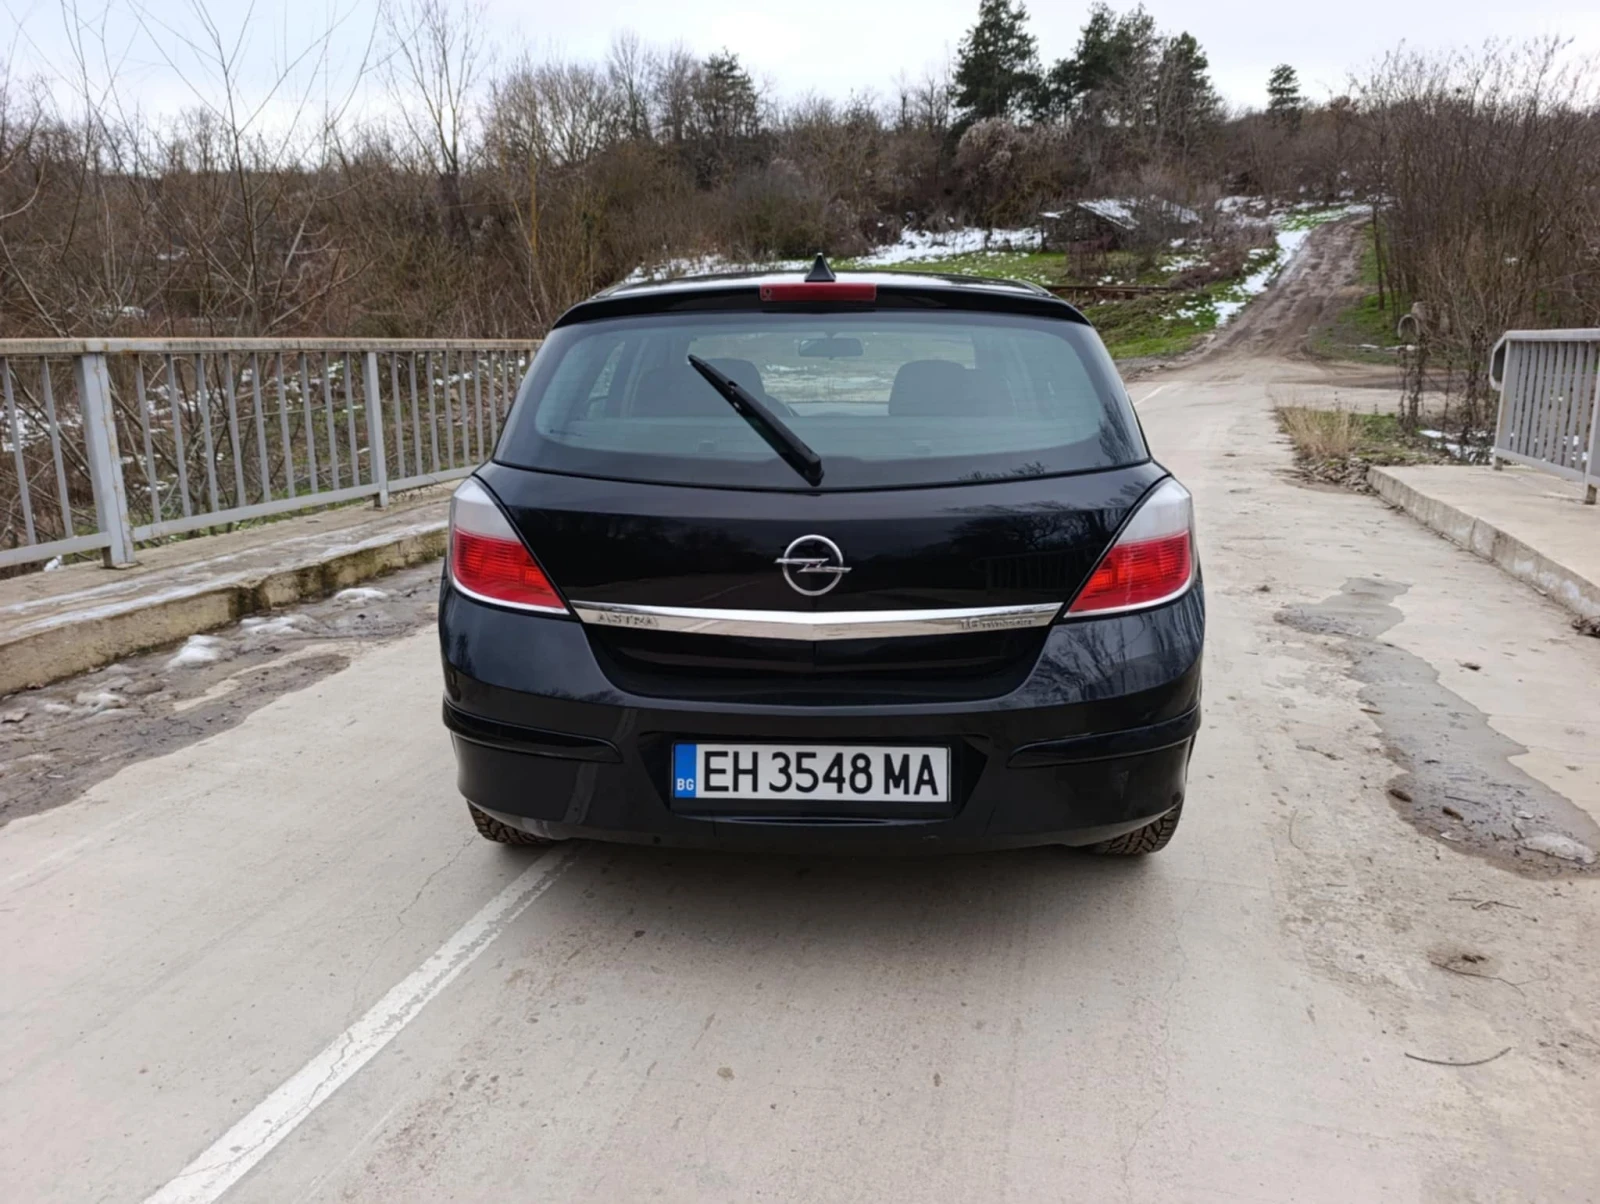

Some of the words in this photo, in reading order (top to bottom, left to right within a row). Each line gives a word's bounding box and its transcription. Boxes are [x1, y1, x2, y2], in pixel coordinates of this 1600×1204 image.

[598, 612, 659, 627] ASTRA
[704, 751, 758, 792] EH
[769, 751, 873, 794] 3548
[884, 753, 939, 796] MA
[677, 778, 694, 791] BG
